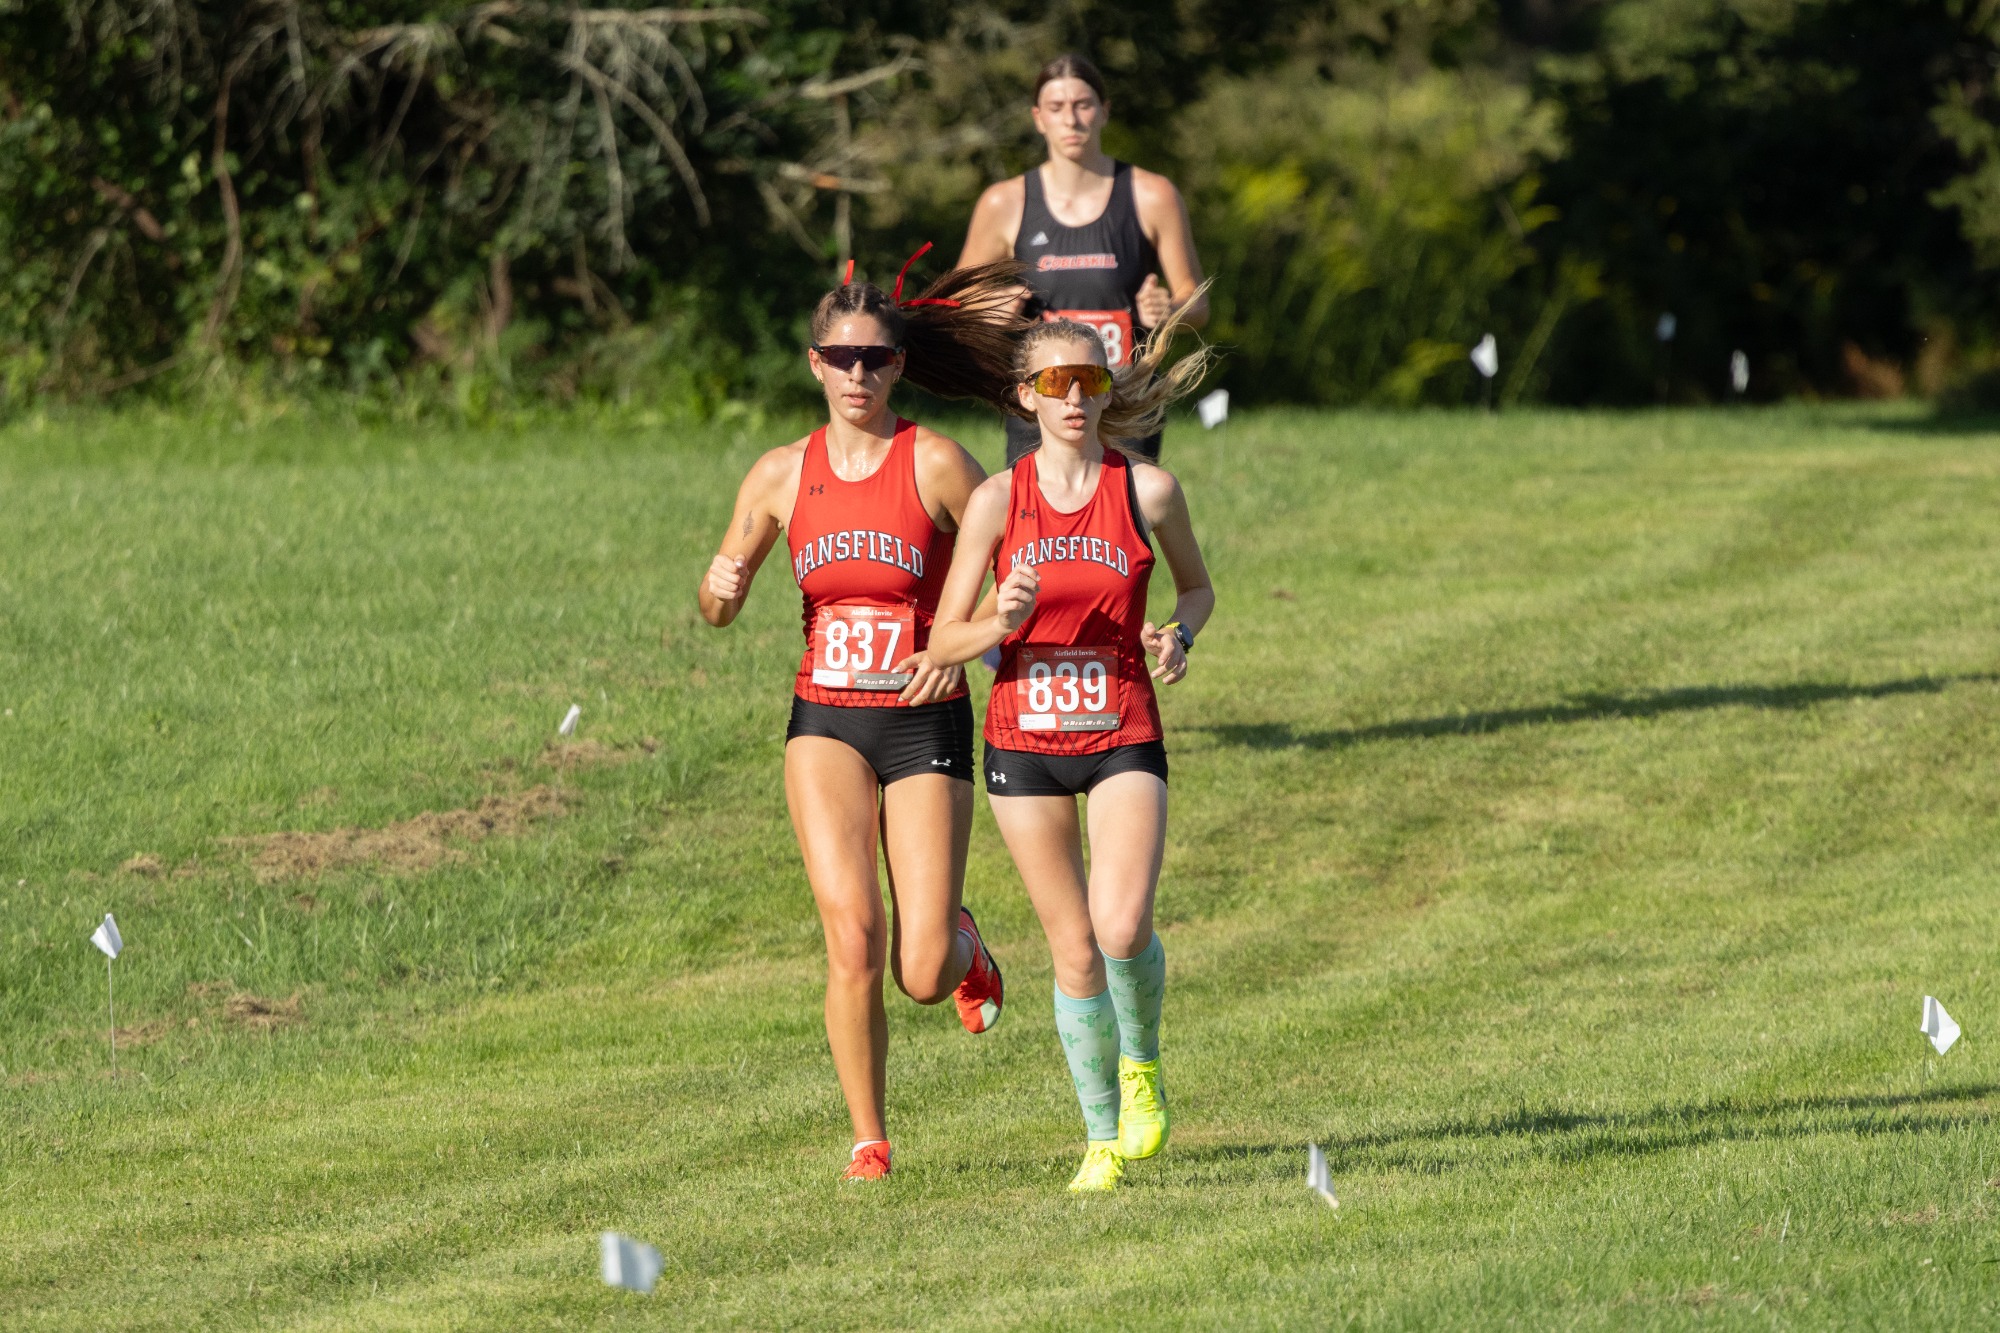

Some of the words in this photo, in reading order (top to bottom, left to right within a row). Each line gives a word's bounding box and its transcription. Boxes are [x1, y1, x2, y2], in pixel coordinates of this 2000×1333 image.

[1037, 253, 1119, 272] COBLESKILL
[795, 529, 924, 587] MANSFIELD
[1010, 535, 1129, 578] MANSFIELD
[825, 620, 902, 671] 837
[1028, 661, 1107, 713] 839
